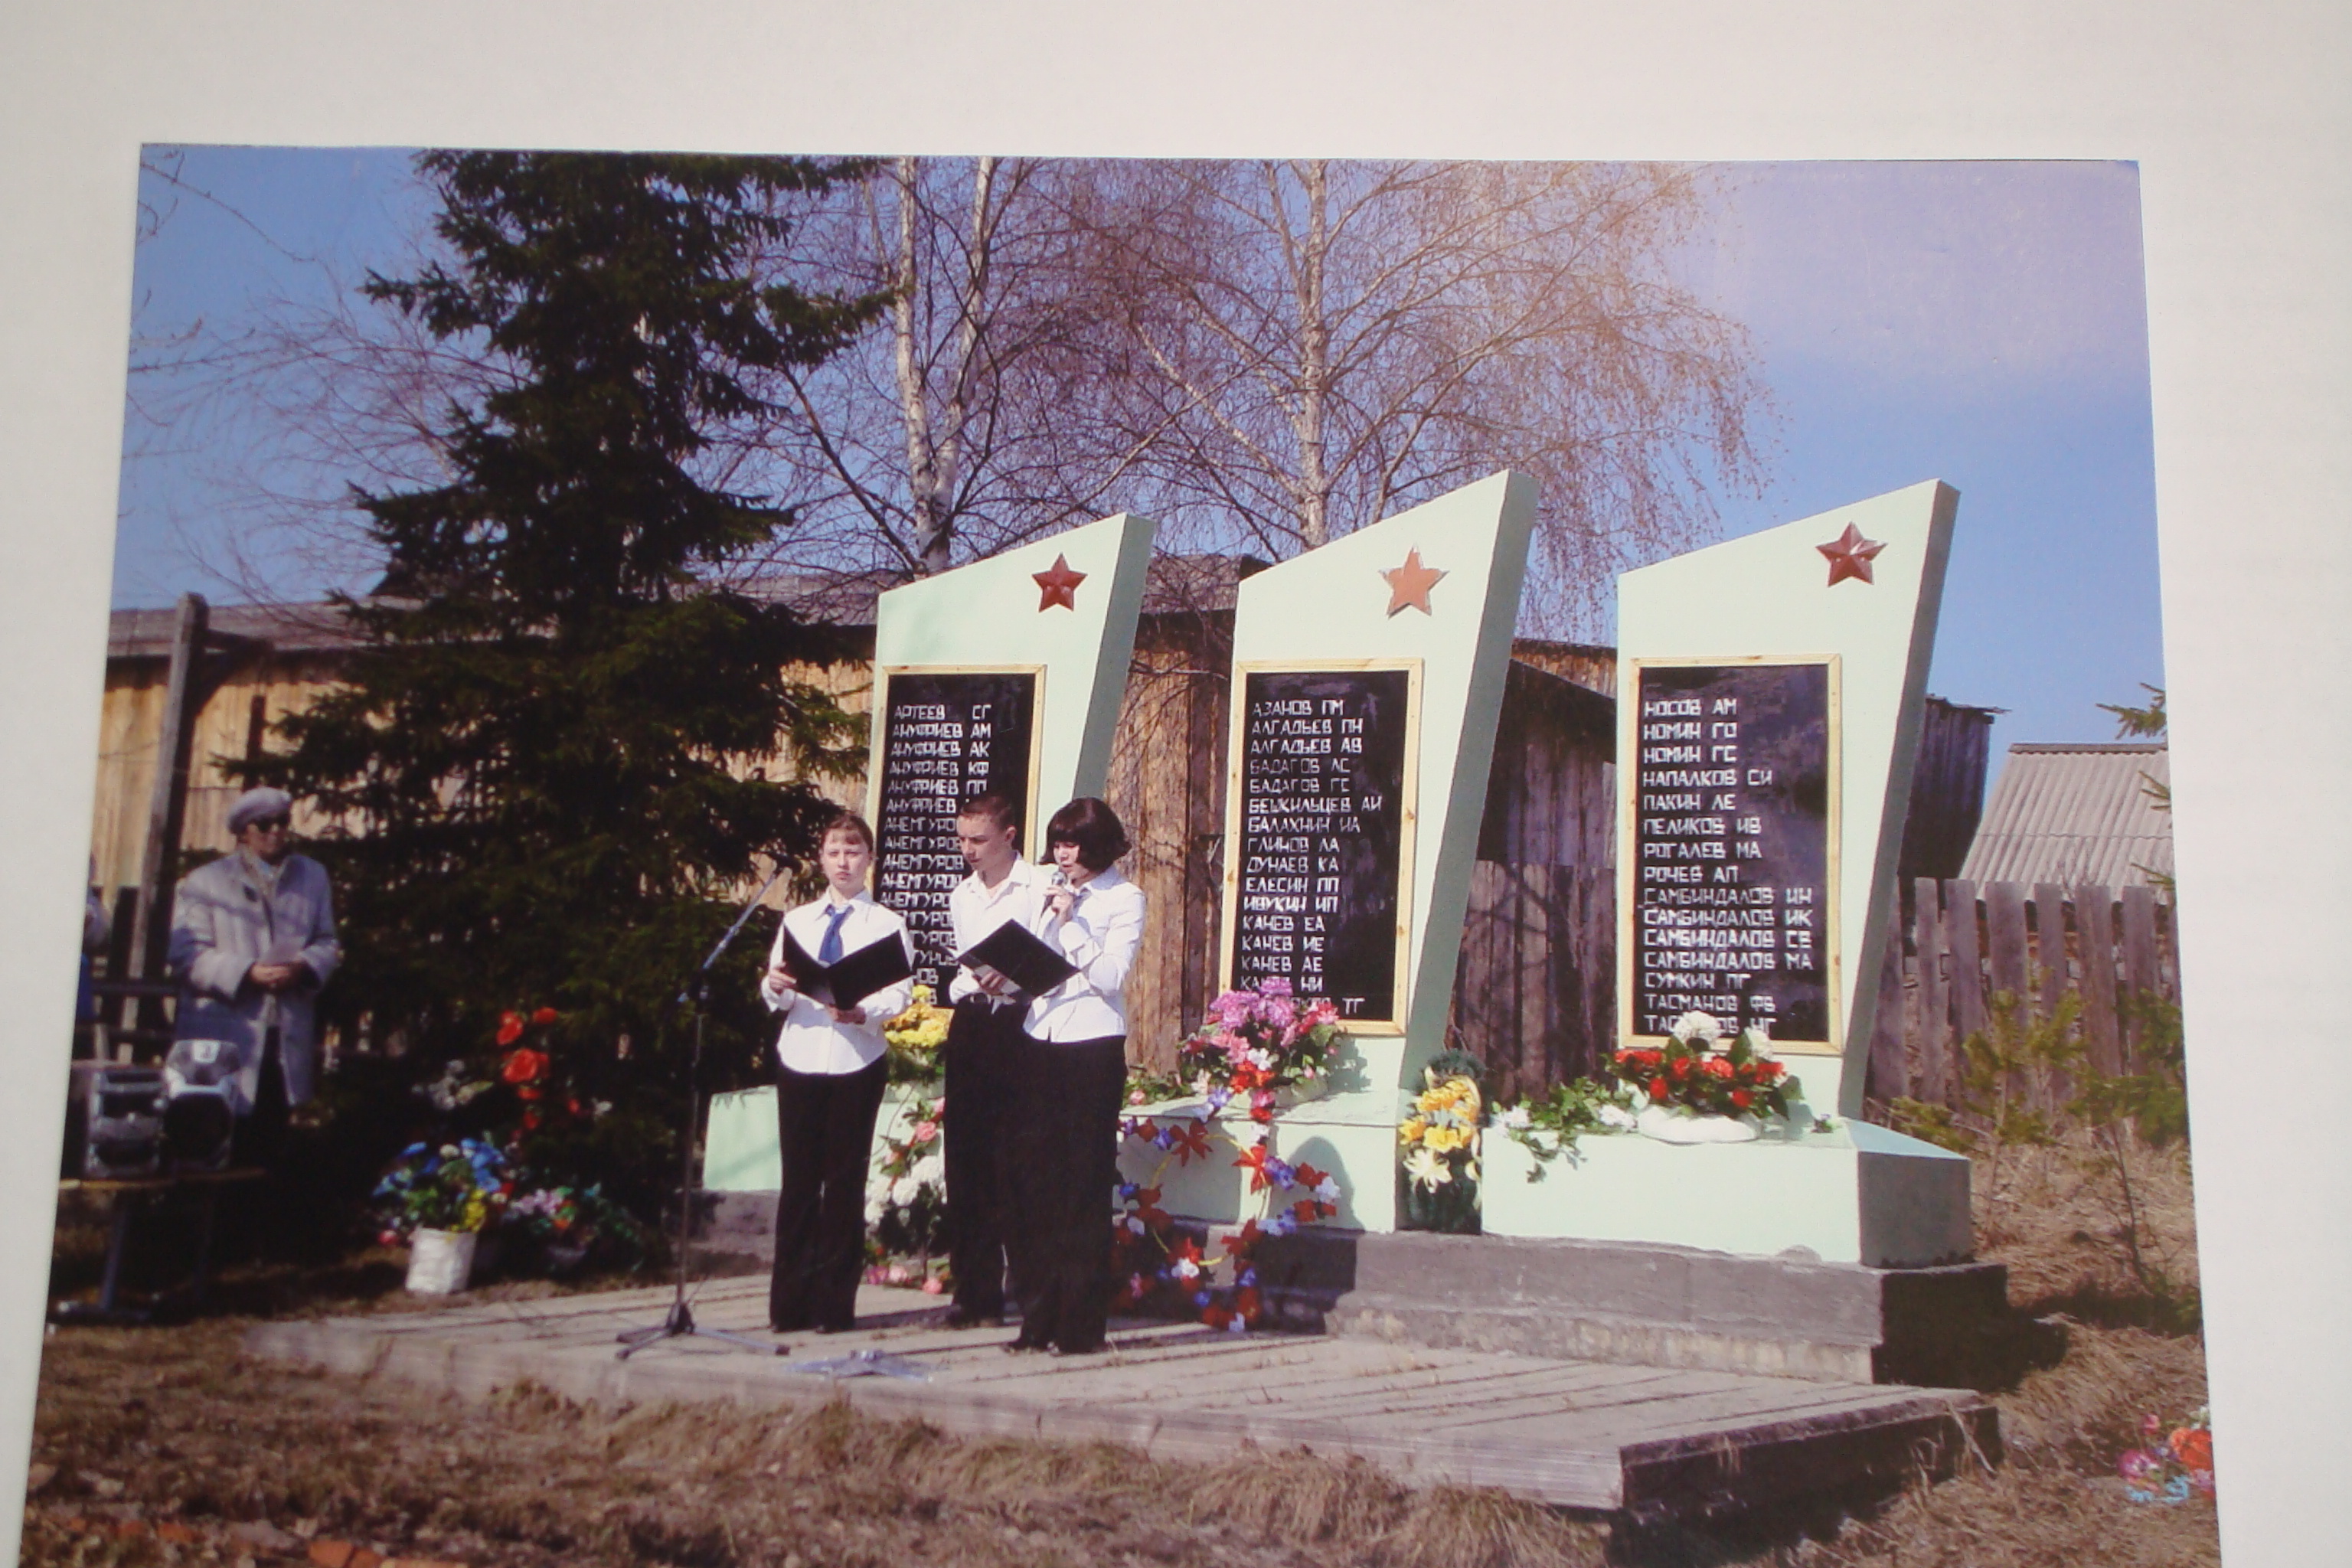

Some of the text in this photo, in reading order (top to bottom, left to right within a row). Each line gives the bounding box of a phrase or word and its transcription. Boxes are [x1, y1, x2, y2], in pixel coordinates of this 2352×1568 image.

[894, 704, 991, 720] АРТЕЕВ СГ
[1252, 699, 1344, 717] АЗАНОВ ПМ
[1645, 698, 1737, 717] НОСОВ АМ
[893, 723, 991, 738] АНУФРИЕВ АМ
[1252, 718, 1364, 736] АЛГАДЬЕВ ПН
[1644, 722, 1737, 740] НОМИН ГО
[969, 741, 991, 757] АК
[1250, 737, 1362, 754] АЛГАДЬЕВ АВ
[1644, 745, 1737, 763] НОМИН ГС
[969, 761, 989, 776] КФ
[1250, 758, 1351, 774] БАДАГОВ ЛС
[1250, 778, 1350, 794] БАДАГОВ ГС
[1643, 769, 1772, 787] НАПАЛКОВ СИ
[887, 779, 987, 795] АНУФРИЕВ ПП
[886, 797, 956, 813] АНУФРИЕВ
[1361, 796, 1382, 811] АИ
[1644, 794, 1736, 811] ПАКИН ЛЕ
[884, 816, 957, 831] АНЕМГУРО
[1248, 816, 1361, 833] БАЛАХНИН ИА
[1644, 817, 1762, 835] ПЕЛИКОВ ИВ
[1248, 837, 1340, 853] ГЛИНОВ ЛА
[1644, 842, 1726, 859] РОГАЛЕВ
[883, 854, 964, 871] АНЕМГУРОВ
[1246, 856, 1339, 874] ДУНАЕВ КА
[1644, 865, 1739, 883] РОЧЕВ АП
[1246, 877, 1339, 893] ЕЛЕСИН ПП
[880, 891, 952, 908] АНЕМГУРО
[1315, 896, 1338, 913] ИП
[1644, 887, 1812, 906] САМБИНДАЛОВ ИН
[1243, 915, 1325, 932] КАНЕВ ЕА
[1644, 909, 1813, 927] САМБИНДАЛОВ ИК
[1242, 935, 1325, 952] КАНЕВ ИЕ
[1644, 929, 1775, 949] САМБИНДАЛОВ
[1242, 956, 1323, 972] КАНЕВ АЕ
[1644, 951, 1813, 971] САМБИНДАЛОВ МА
[1645, 972, 1751, 990] СУМКИН ПГ
[1342, 998, 1365, 1014] ТГ
[1644, 994, 1738, 1012] ТАСМАНОВ
[1643, 1014, 1740, 1034] ТАСОВ
